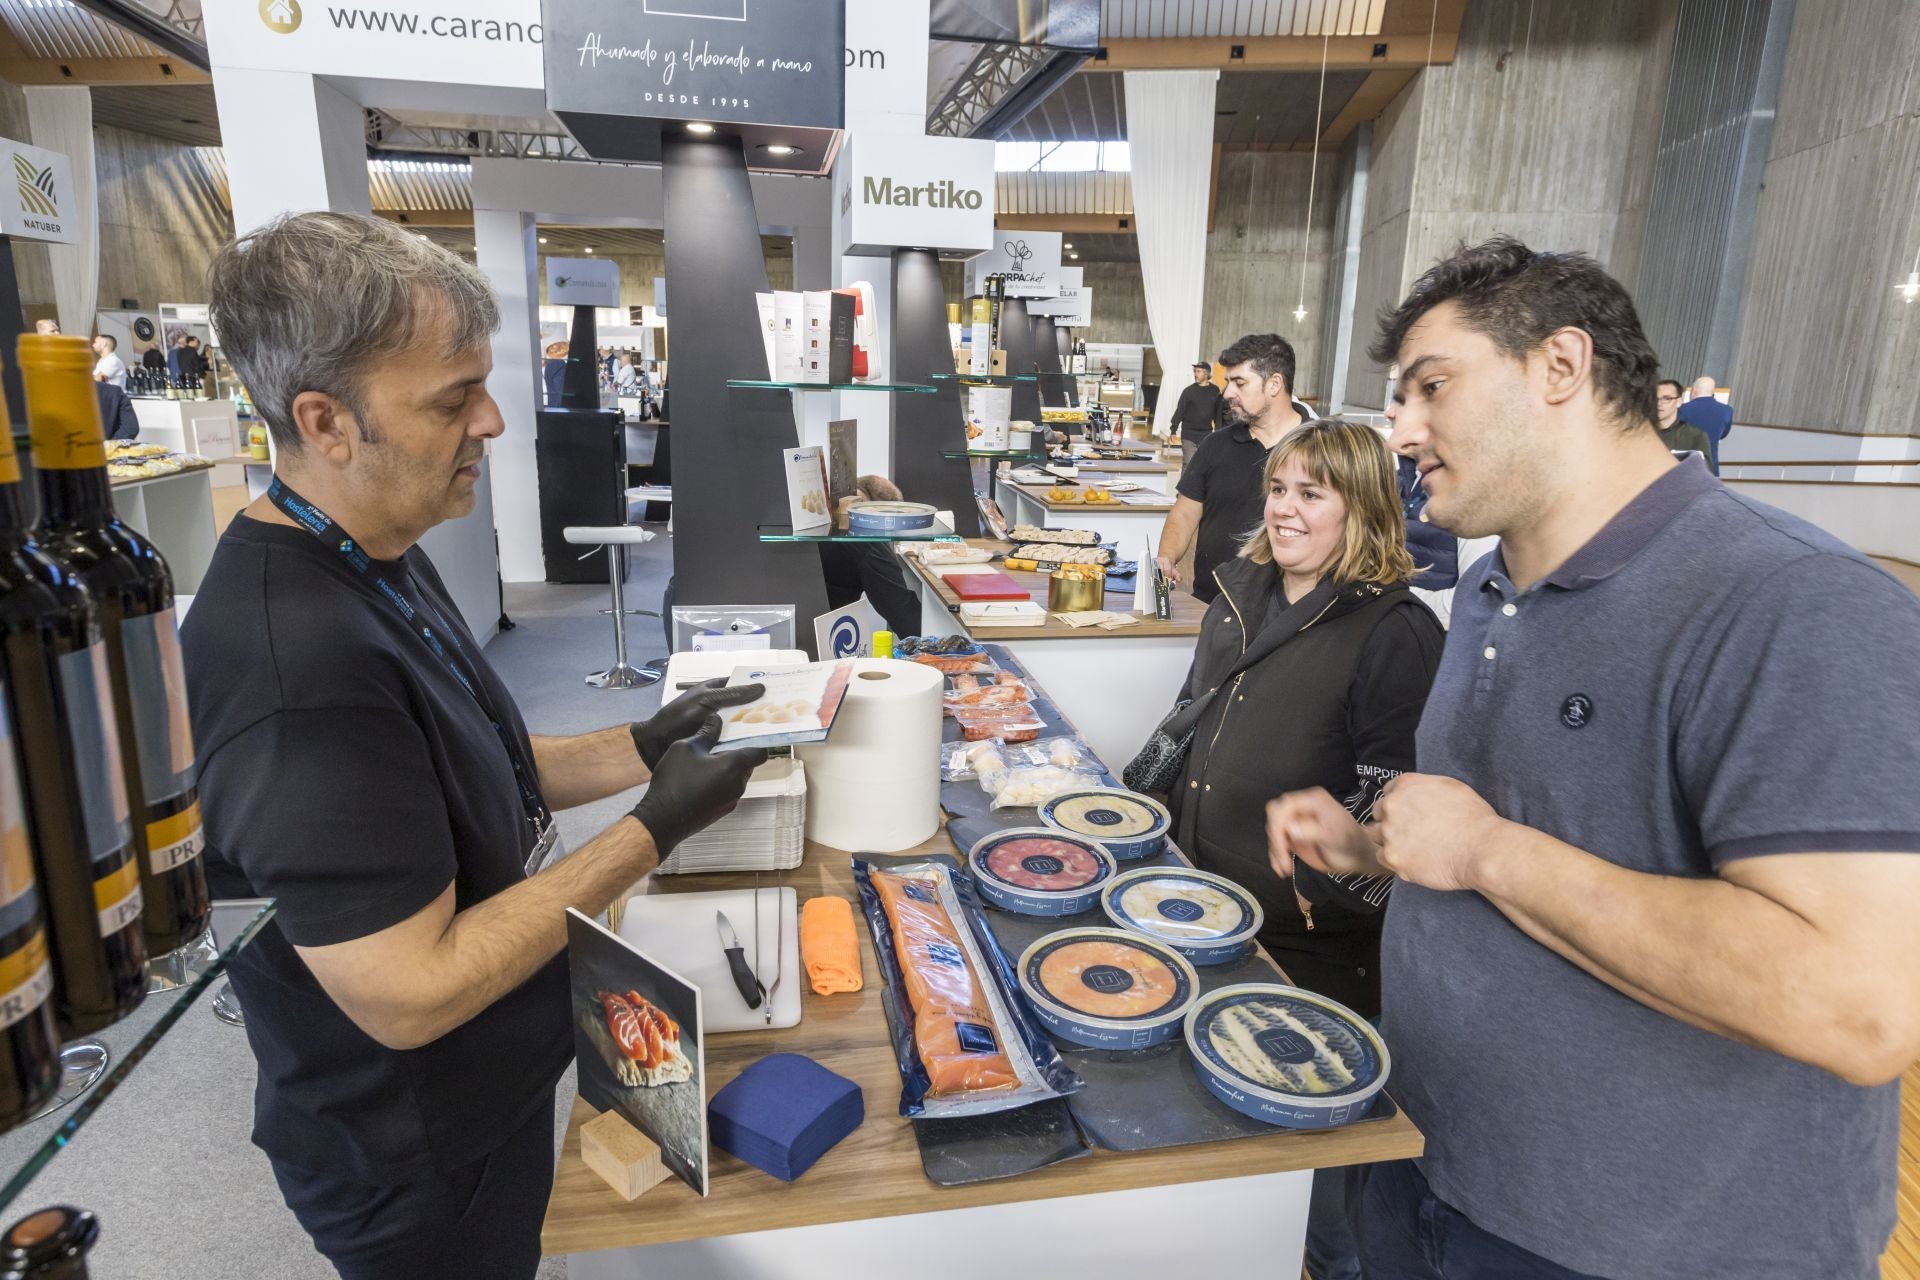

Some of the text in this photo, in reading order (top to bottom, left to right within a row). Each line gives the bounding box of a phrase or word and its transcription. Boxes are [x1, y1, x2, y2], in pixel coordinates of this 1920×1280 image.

[576, 31, 812, 85] Ahumado y elaborado a mano
[644, 92, 750, 108] DESDE 1995
[863, 176, 983, 211] Martiko
[23, 218, 62, 234] NATUBER
